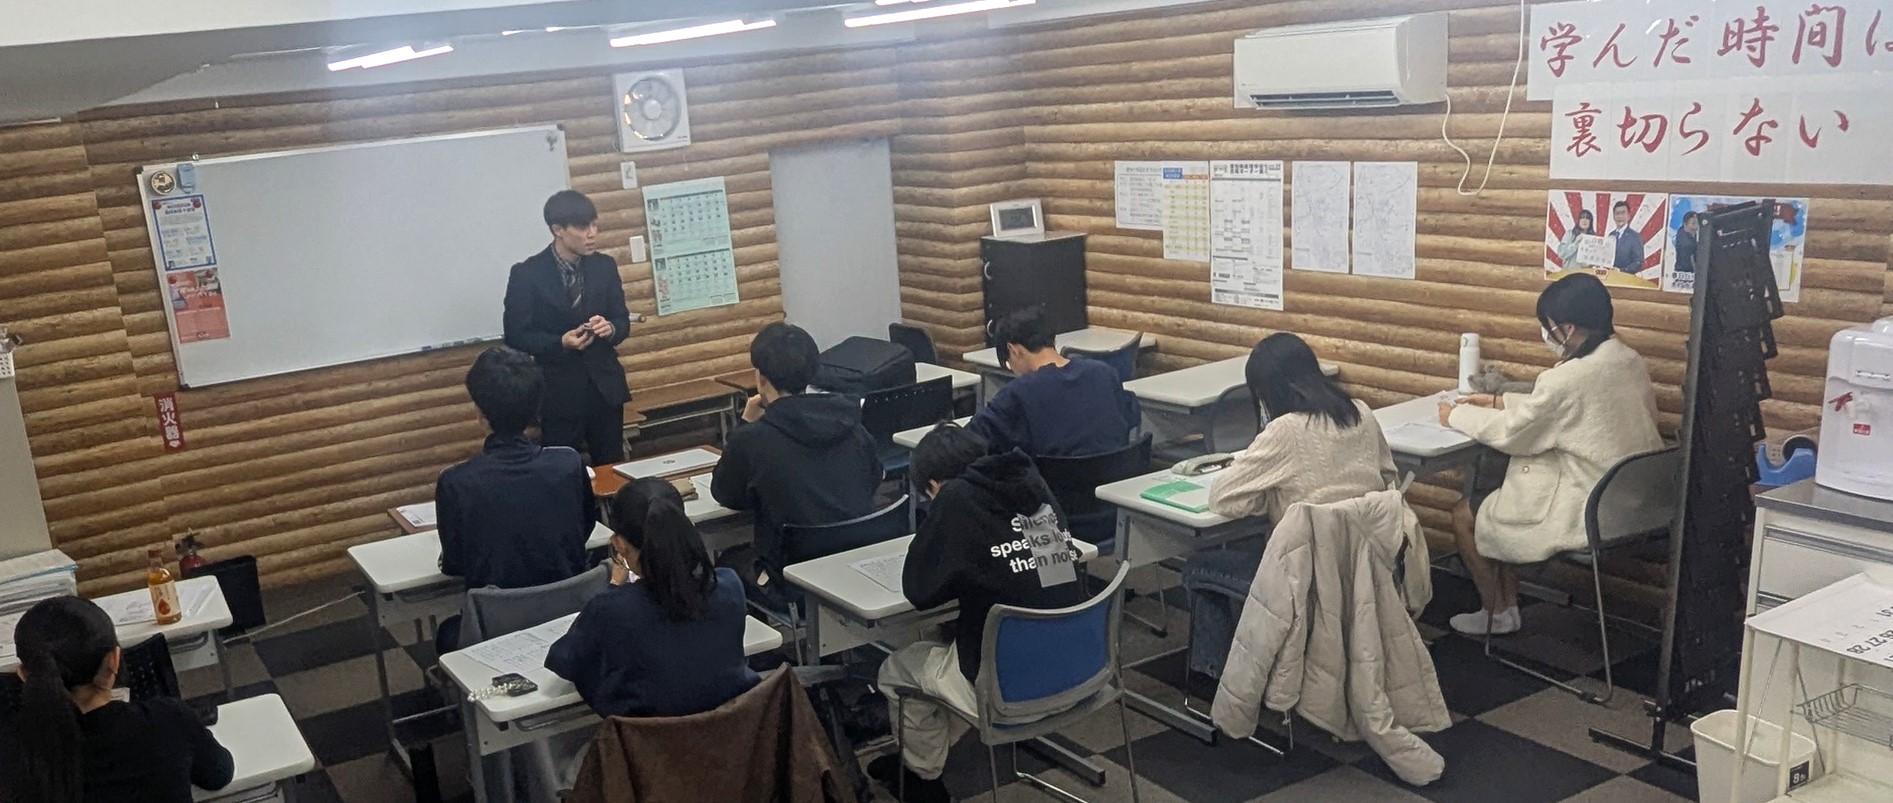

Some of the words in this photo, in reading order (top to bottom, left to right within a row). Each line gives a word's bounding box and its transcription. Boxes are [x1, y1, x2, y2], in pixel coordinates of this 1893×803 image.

[1564, 98, 1850, 158] 裏切らない
[157, 397, 179, 440] 消火器
[1011, 512, 1058, 532] silenc
[990, 533, 1051, 558] speaks
[1009, 554, 1049, 573] than
